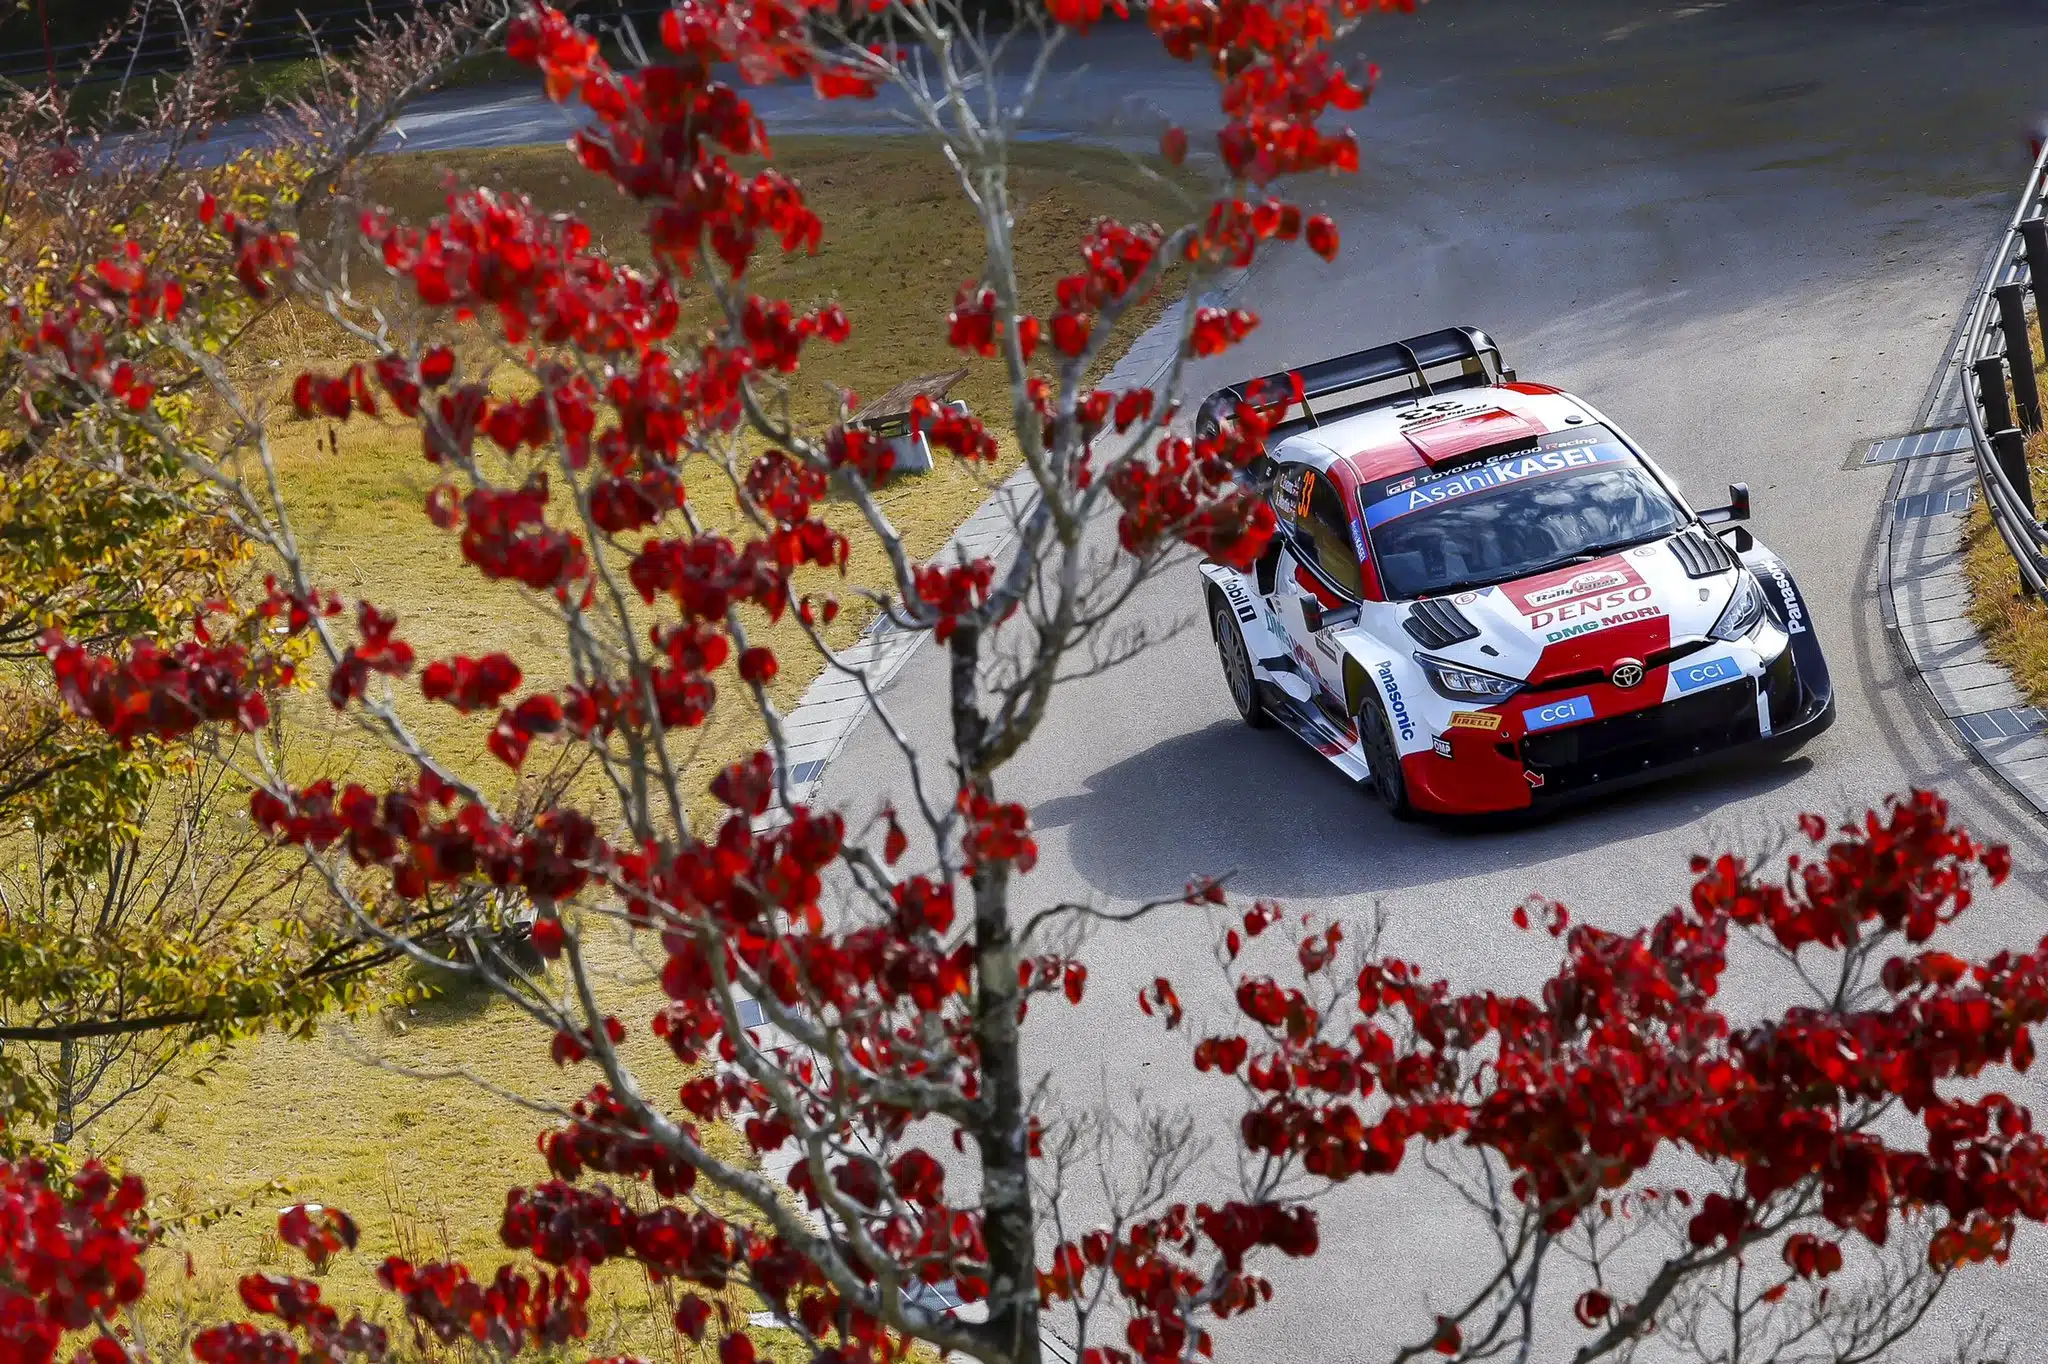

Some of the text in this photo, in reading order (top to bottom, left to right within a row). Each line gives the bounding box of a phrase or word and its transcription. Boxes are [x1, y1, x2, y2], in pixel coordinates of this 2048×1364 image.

[1409, 448, 1598, 510] AsahiKASEI
[1420, 437, 1598, 483] TOYOTA GAZOO Racing
[1298, 471, 1315, 518] 33
[1388, 478, 1415, 496] GR
[1530, 587, 1652, 630] DENSO
[1536, 588, 1574, 602] Rally
[1761, 560, 1806, 635] Panaso
[1546, 605, 1661, 643] DMG MORI
[1375, 660, 1416, 741] Panasonic
[1452, 713, 1496, 727] PIRELLI
[1433, 740, 1451, 754] OMP
